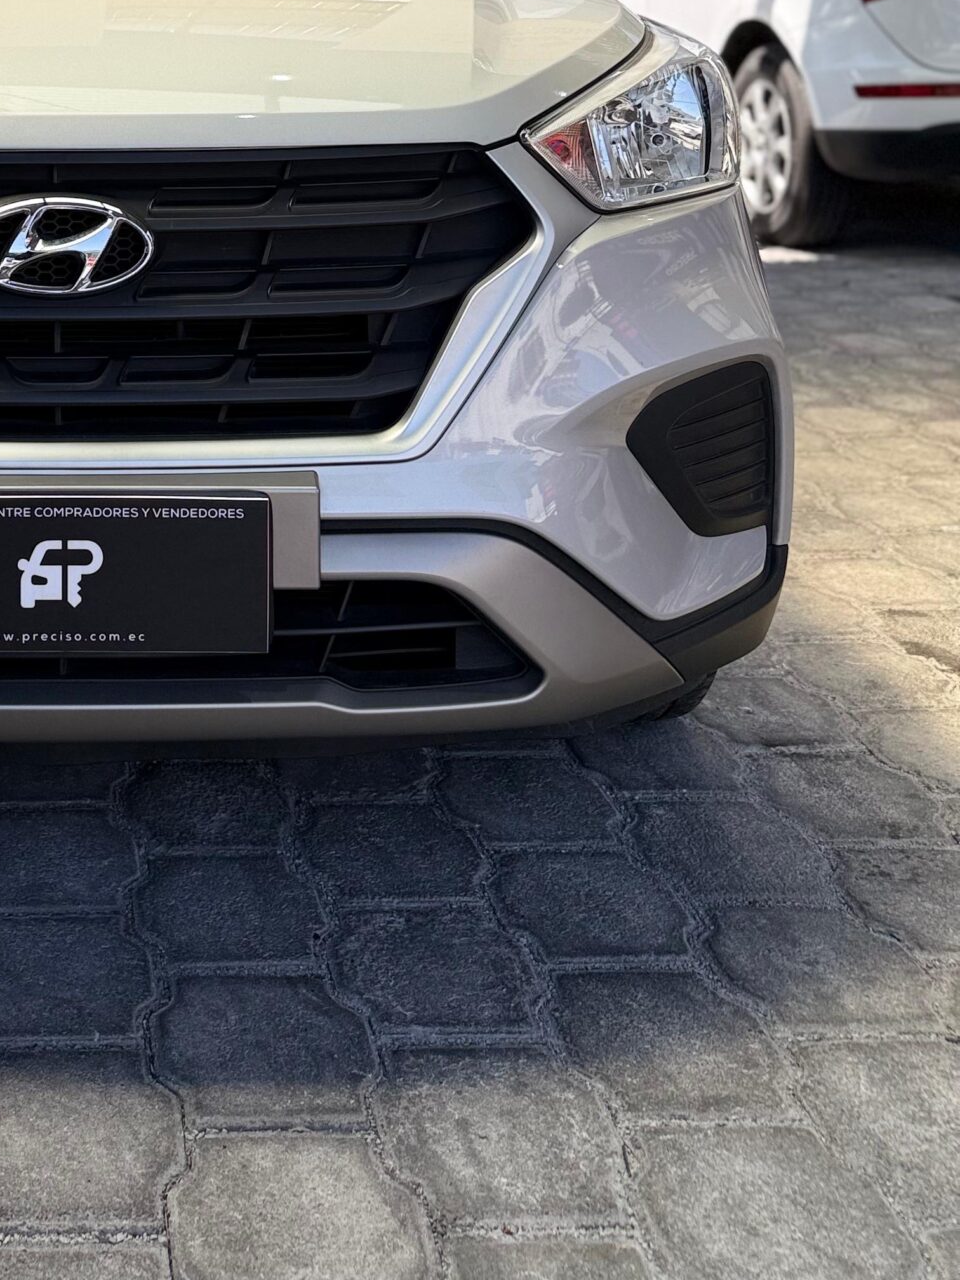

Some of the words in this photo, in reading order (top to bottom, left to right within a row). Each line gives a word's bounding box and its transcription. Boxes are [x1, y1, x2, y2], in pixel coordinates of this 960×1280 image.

[34, 507, 139, 518] COMPRADORES
[141, 508, 150, 518] Y
[152, 508, 245, 519] VENDEDORES
